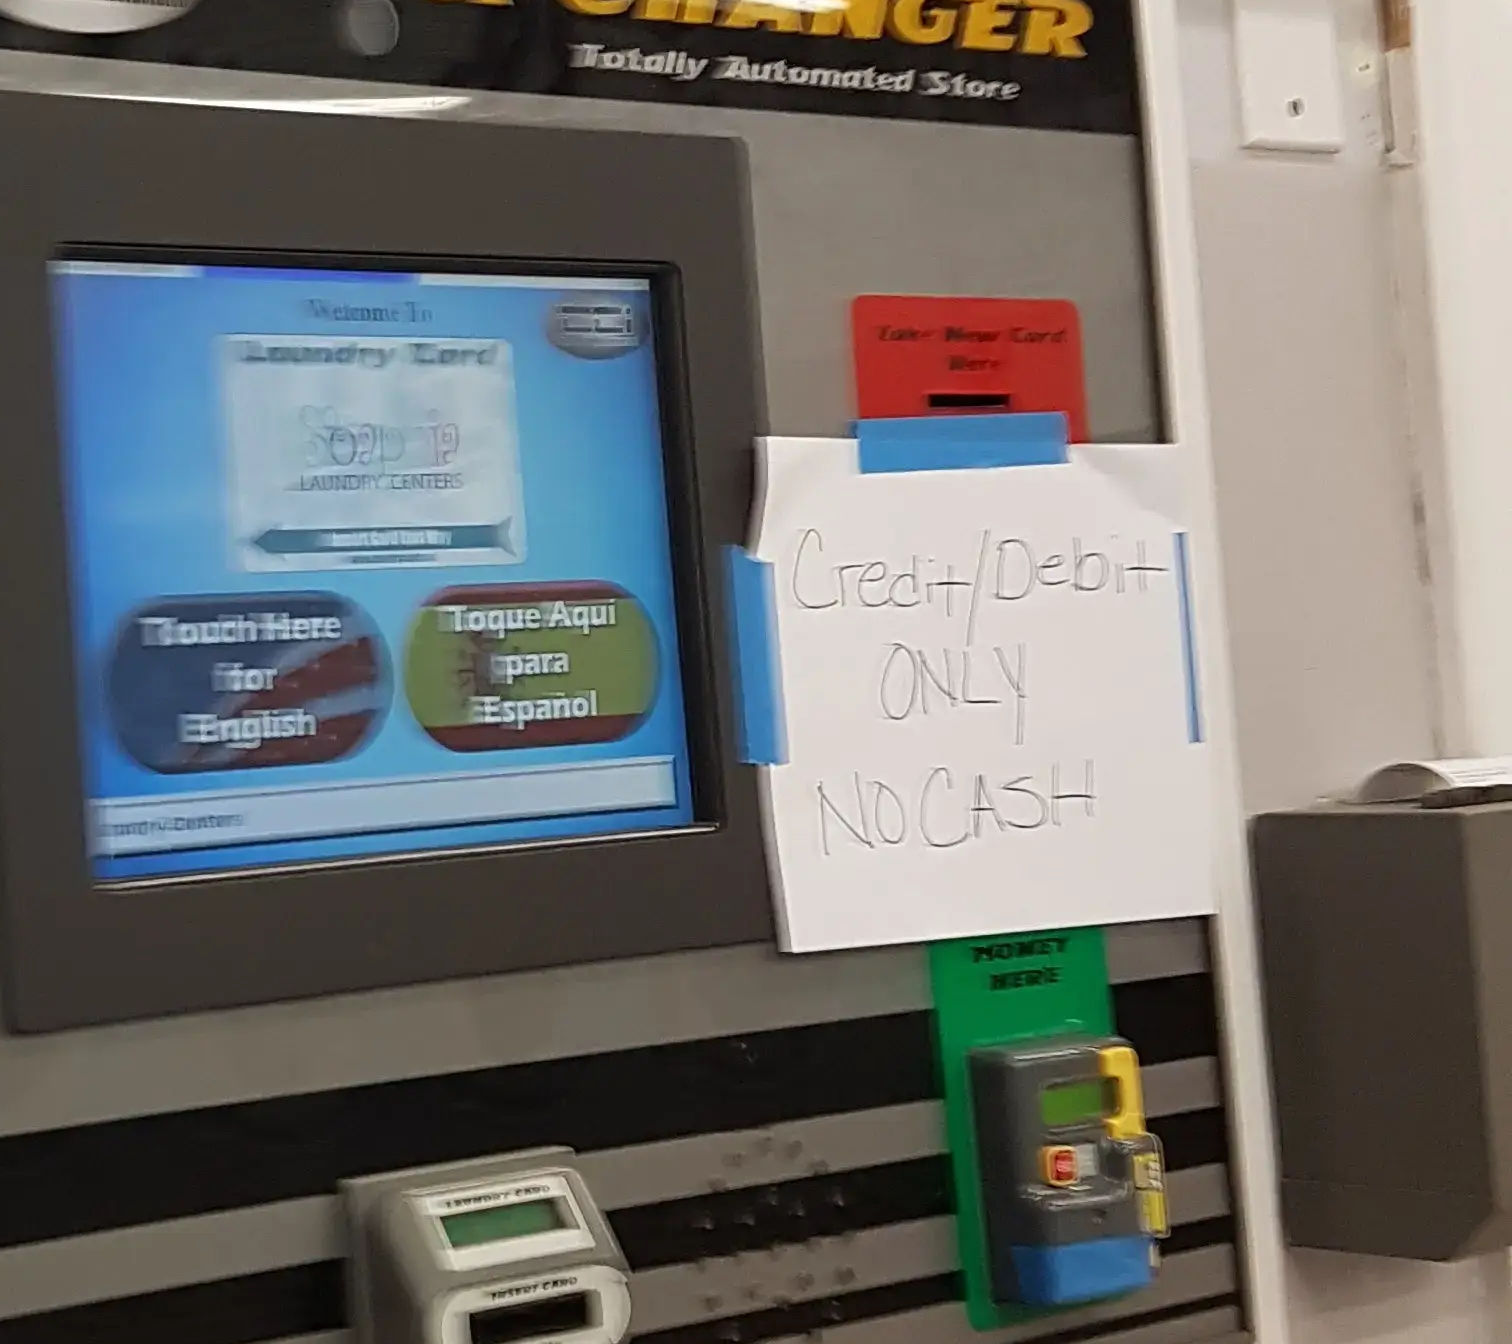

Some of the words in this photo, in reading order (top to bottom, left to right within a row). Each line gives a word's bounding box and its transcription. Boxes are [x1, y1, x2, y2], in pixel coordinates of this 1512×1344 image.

[568, 43, 708, 83] Totally
[714, 56, 914, 93] Automated
[919, 69, 1023, 101] Store
[299, 472, 380, 492] LAUNDRY
[390, 471, 465, 491] CENTERS
[792, 527, 1171, 647] Credit/Debit
[137, 614, 257, 647] Touch
[252, 612, 343, 642] Here
[437, 605, 541, 639] Toque
[210, 662, 278, 692] for
[491, 651, 570, 685] para
[881, 642, 1027, 746] ONLY
[177, 707, 318, 749] English
[817, 771, 907, 857] NO
[920, 758, 1099, 848] CASH
[971, 936, 1068, 964] MONEY
[988, 965, 1064, 992] HERE
